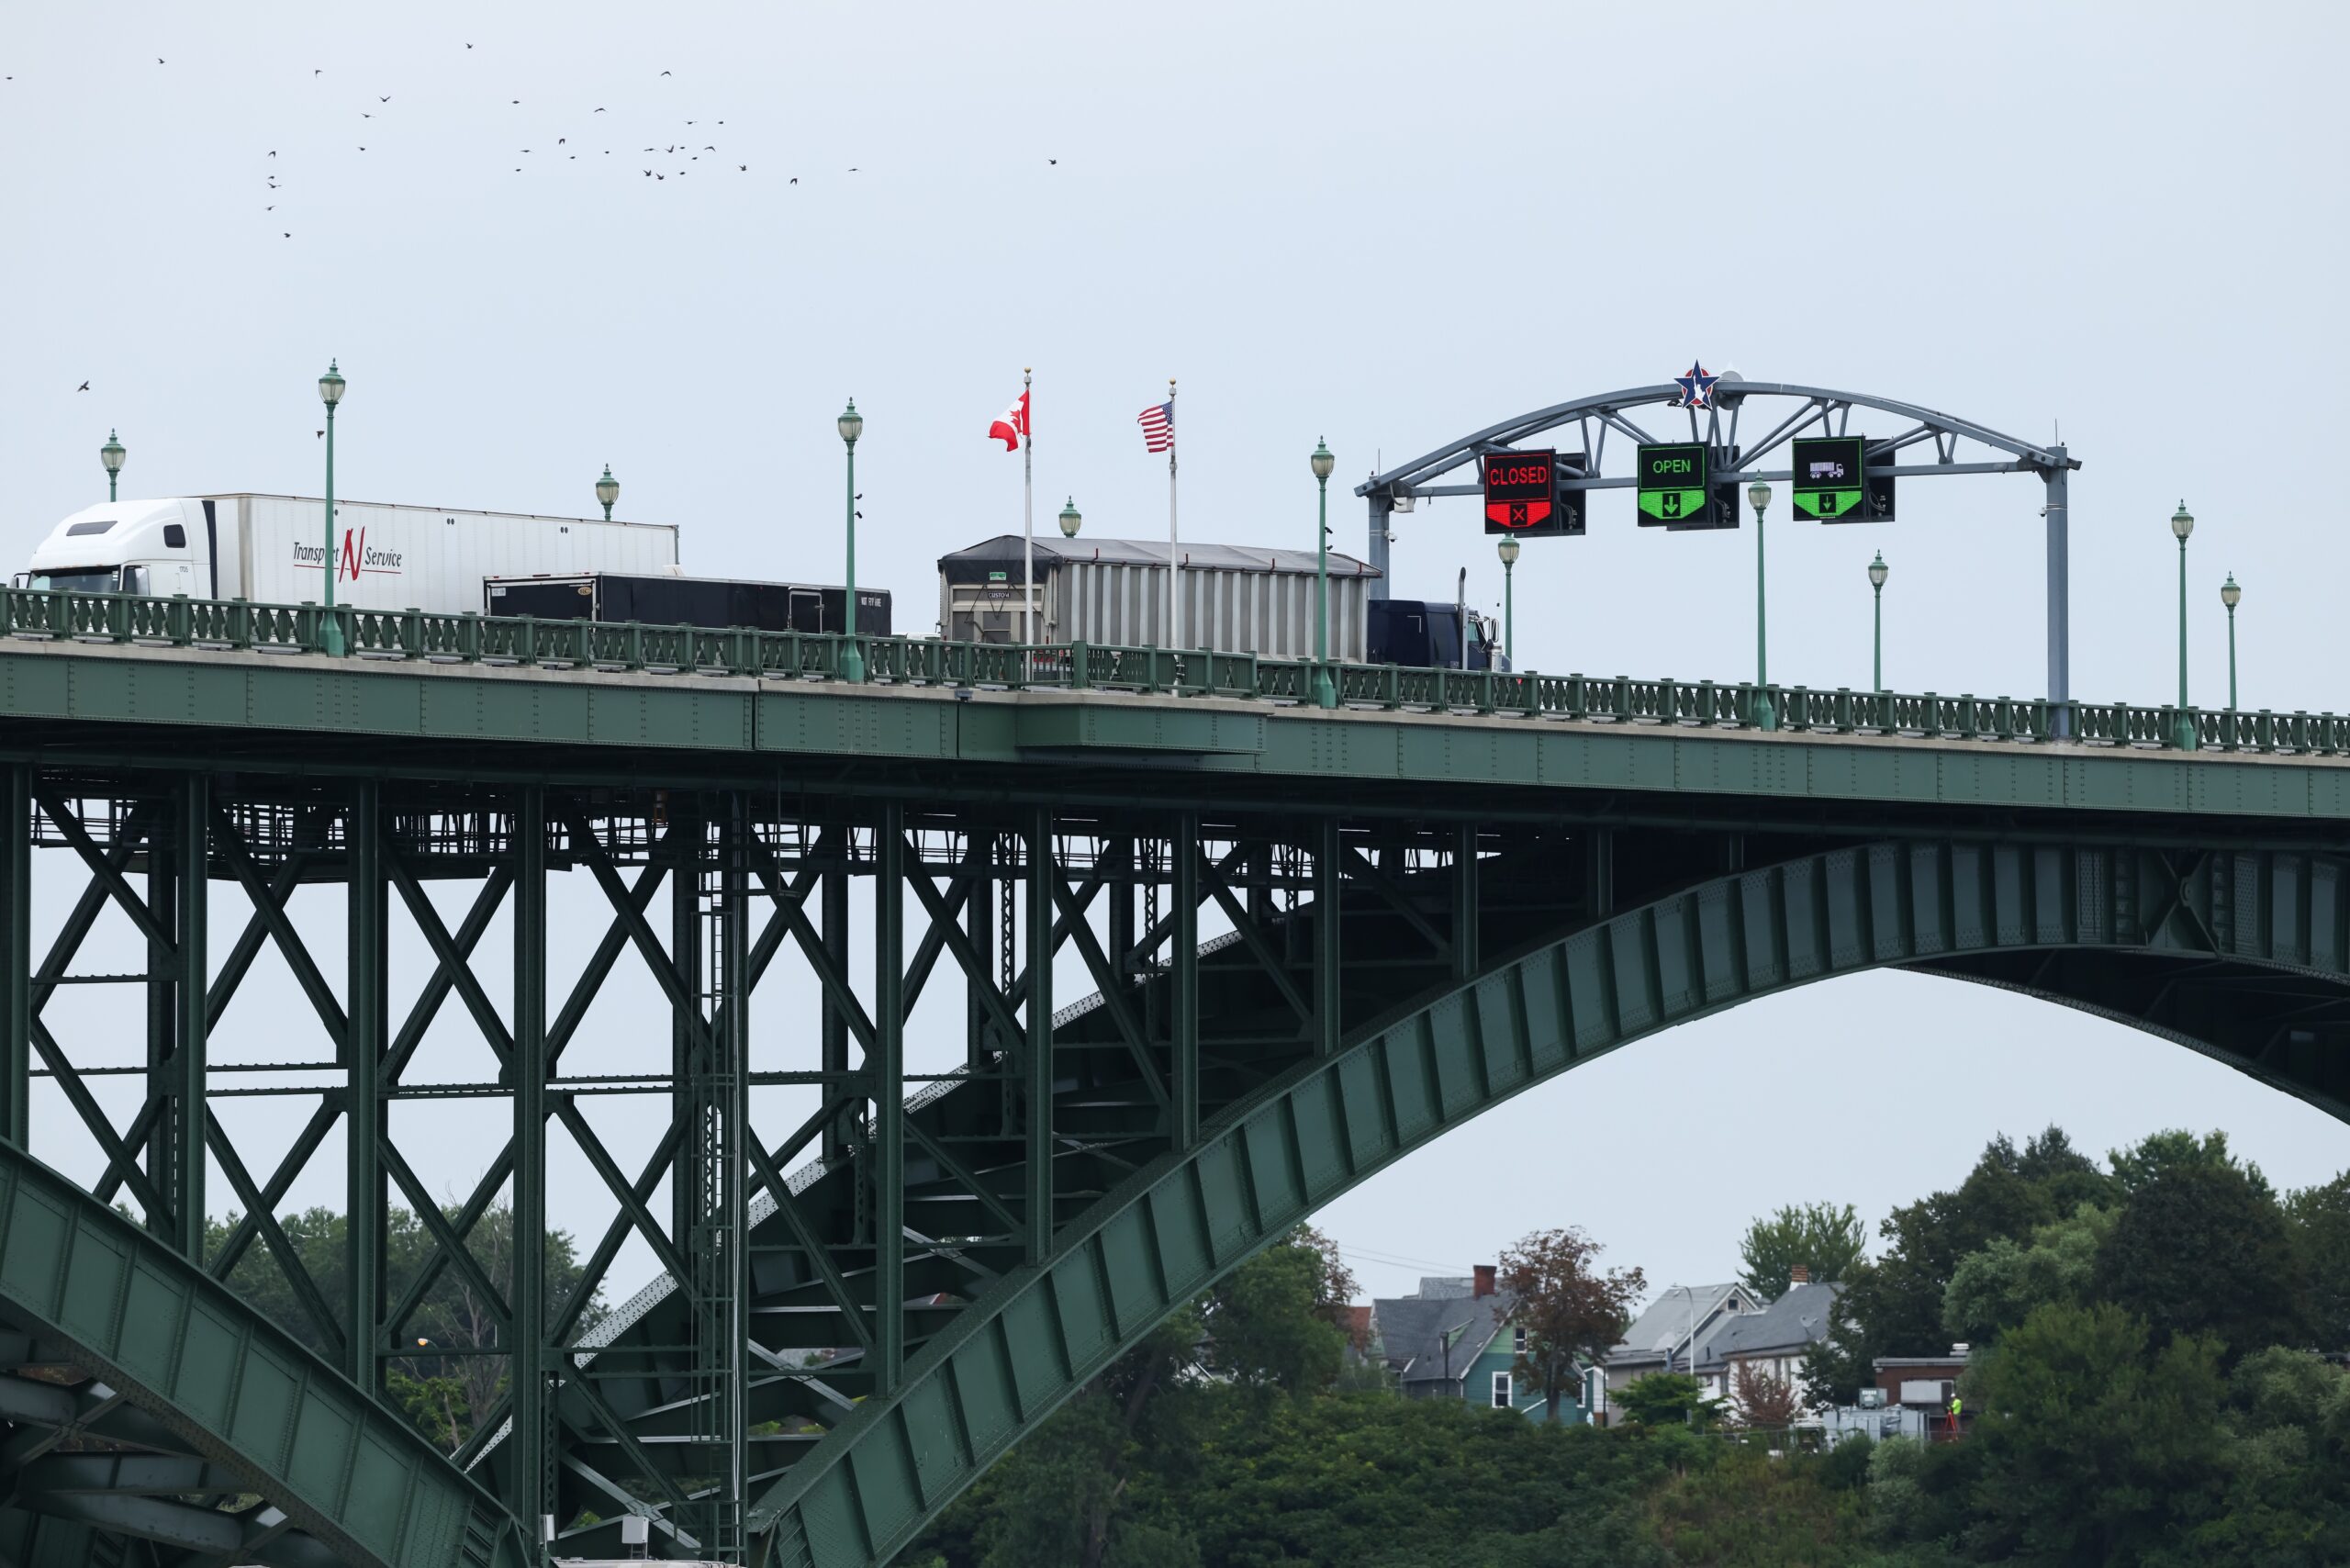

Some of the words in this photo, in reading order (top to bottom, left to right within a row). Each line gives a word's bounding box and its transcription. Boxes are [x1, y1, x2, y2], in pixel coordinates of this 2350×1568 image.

[1490, 465, 1547, 486] CLOSED
[1652, 459, 1691, 474] OPEN
[293, 542, 340, 565] Transpt
[364, 546, 402, 567] Service
